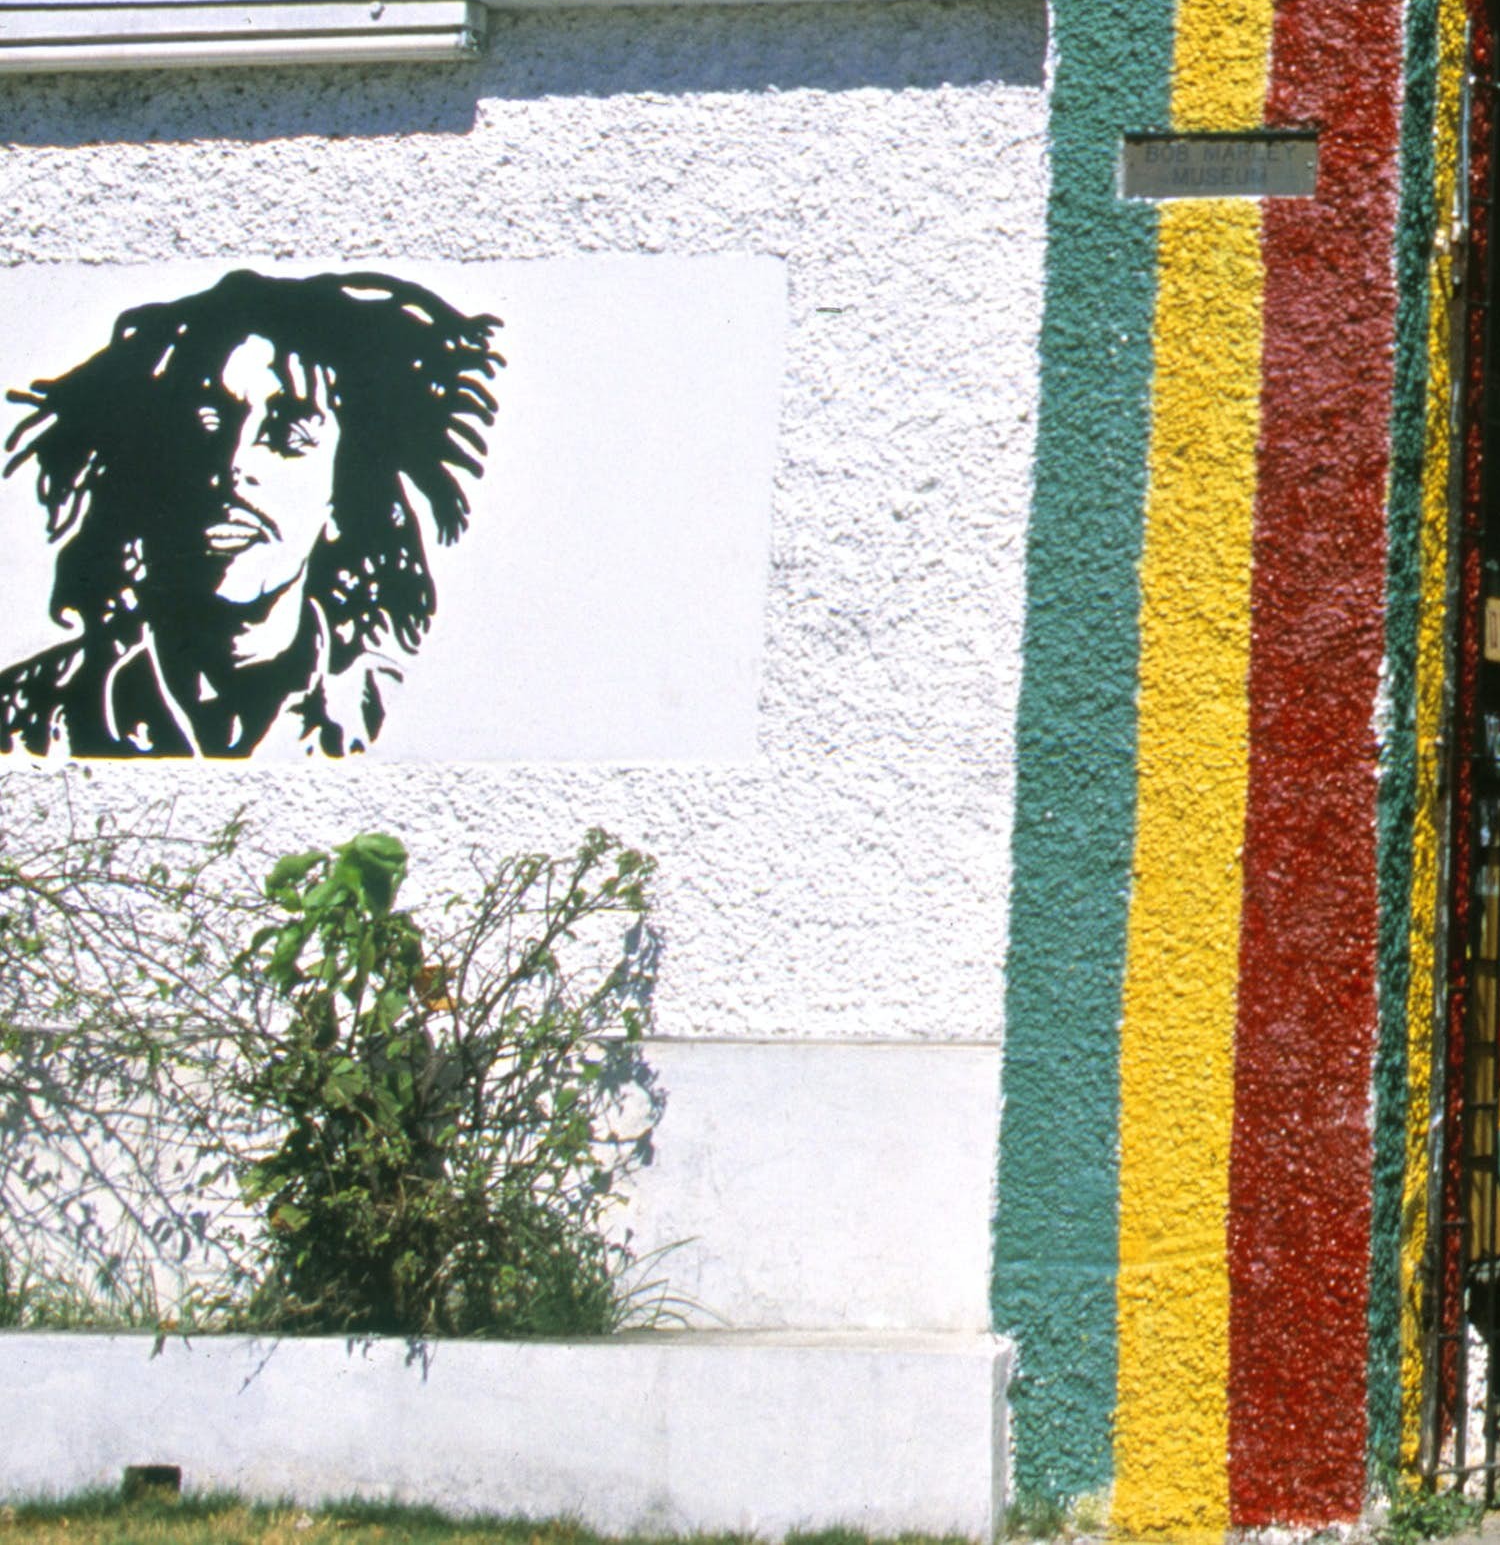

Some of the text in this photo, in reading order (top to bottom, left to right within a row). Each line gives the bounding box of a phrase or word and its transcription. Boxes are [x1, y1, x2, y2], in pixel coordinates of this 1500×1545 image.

[1145, 143, 1297, 163] BOB MARLEY
[1172, 166, 1268, 187] MUSEUM
